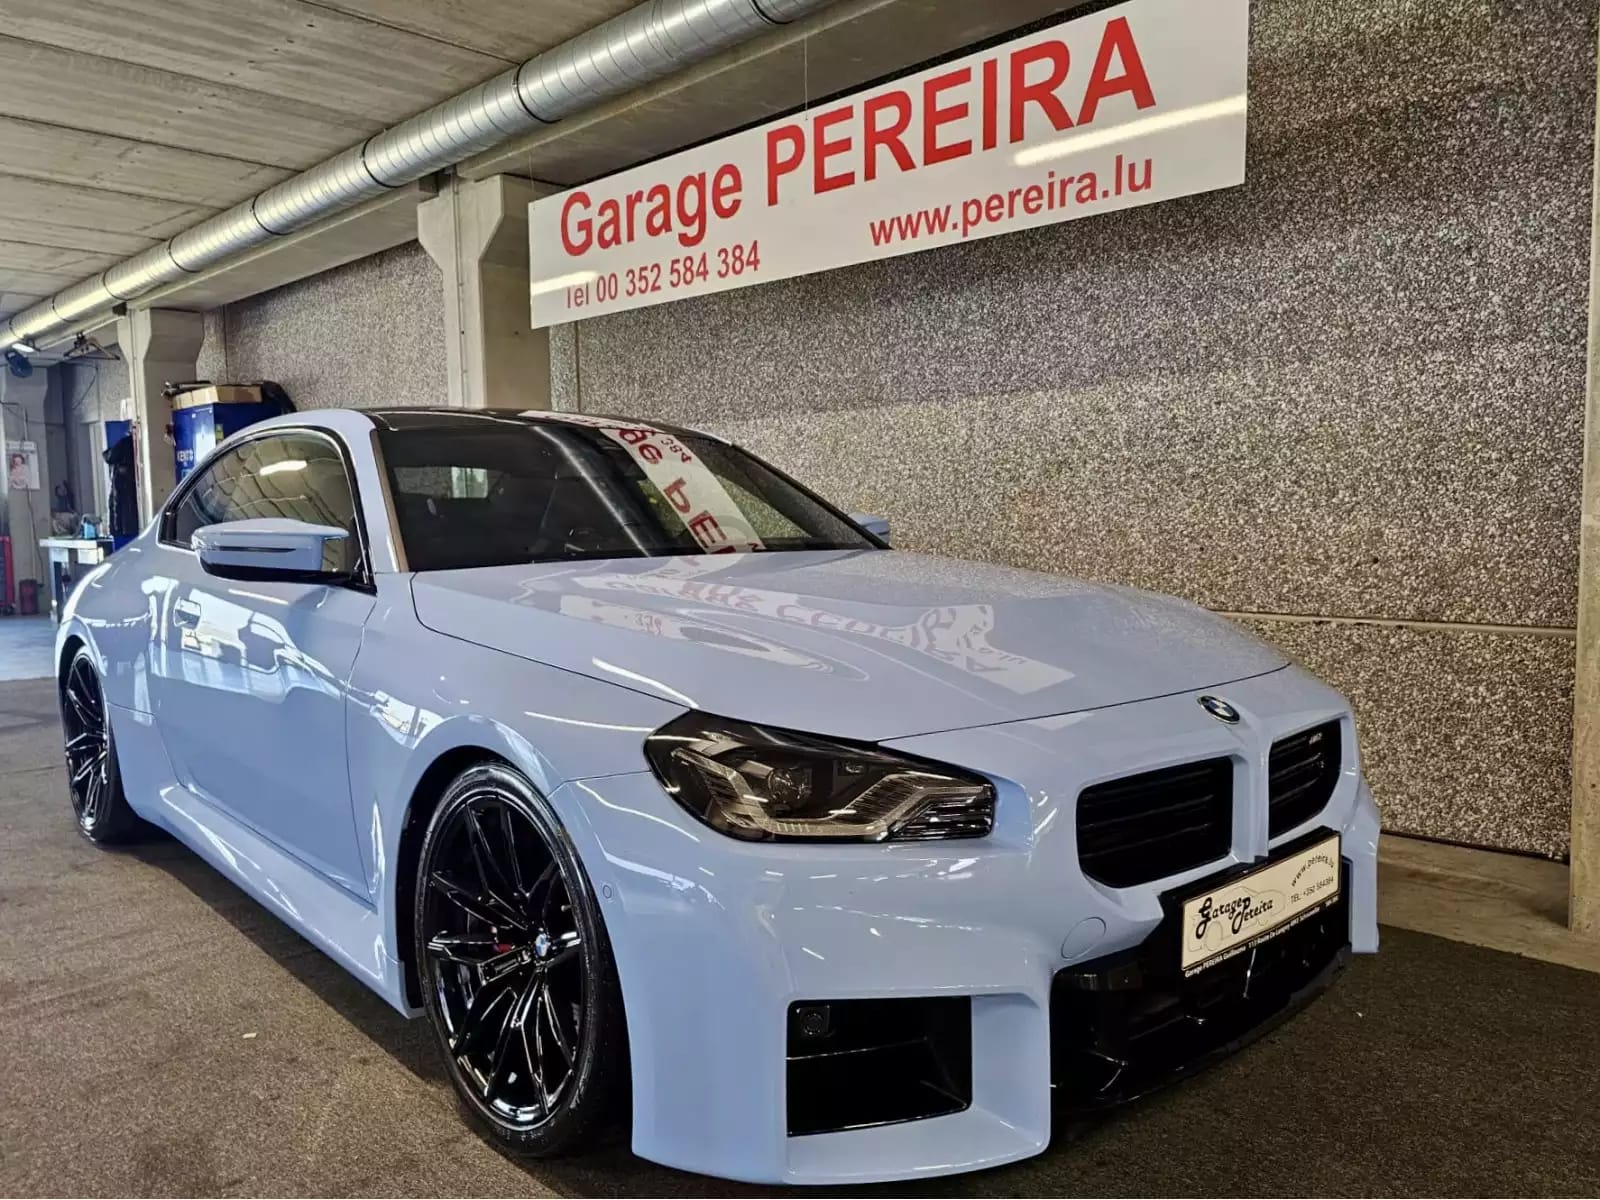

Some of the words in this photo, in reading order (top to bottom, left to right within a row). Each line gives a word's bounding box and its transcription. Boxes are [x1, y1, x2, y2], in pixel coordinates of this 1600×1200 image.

[560, 163, 743, 257] Garage
[766, 15, 1157, 207] PEREIRA
[869, 154, 1153, 247] www.pereira.lu
[596, 272, 618, 303] 00
[625, 262, 662, 297] 352
[669, 251, 709, 288] 584
[716, 239, 761, 279] 384
